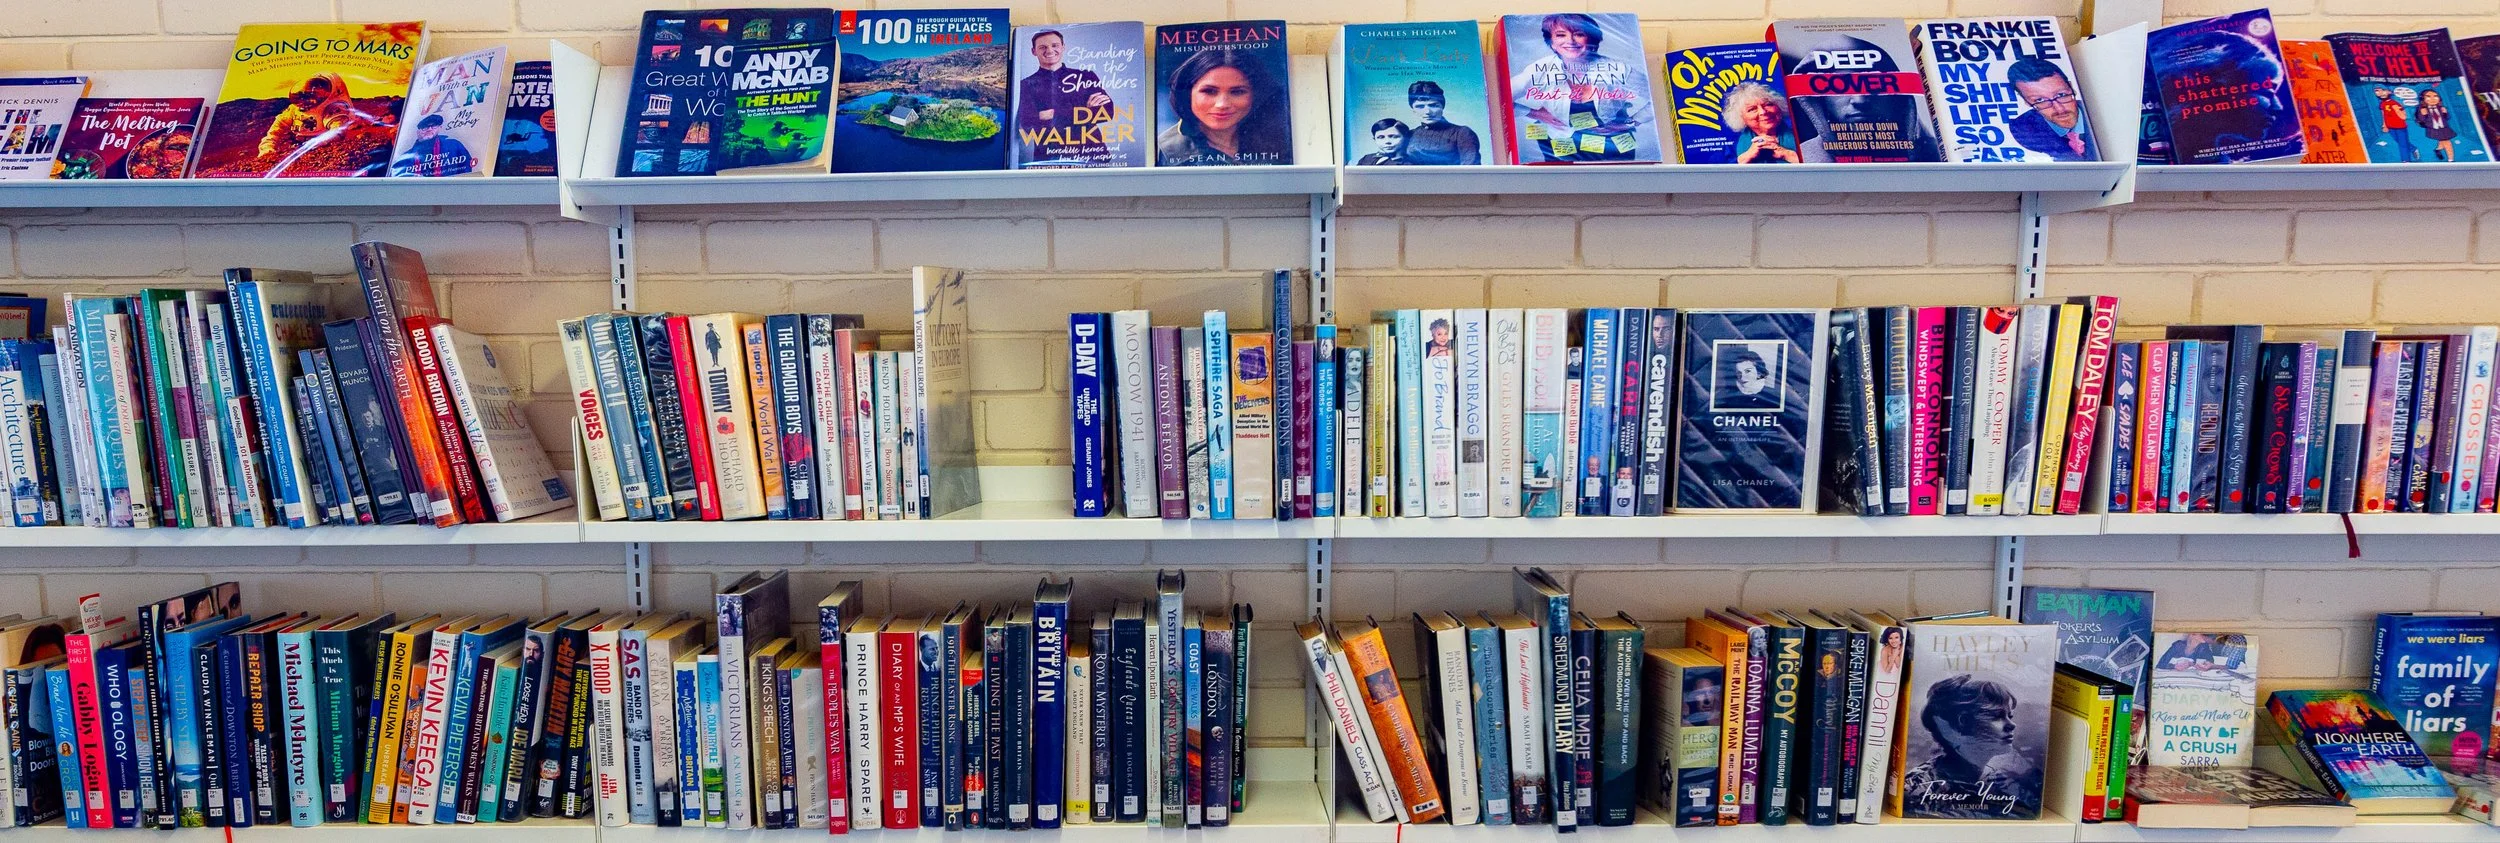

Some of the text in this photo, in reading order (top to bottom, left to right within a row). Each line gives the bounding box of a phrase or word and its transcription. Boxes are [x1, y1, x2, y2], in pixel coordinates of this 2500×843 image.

[859, 18, 911, 45] 100
[915, 34, 992, 44] IN IRELAND
[916, 23, 992, 33] BEST PLACES
[1161, 26, 1281, 46] MEGHAN
[1360, 30, 1407, 38] CHARLES
[1927, 21, 2054, 39] FRANKIE
[235, 38, 318, 62] GOING
[326, 40, 349, 51] TO
[354, 40, 413, 60] MARS
[1066, 42, 1138, 64] Standing
[1174, 42, 1269, 53] MISUNDERSTOOD
[1932, 38, 2061, 62] BOYLE
[2351, 42, 2429, 57] WELCOME TO
[266, 56, 294, 65] STORIES
[743, 49, 821, 72] ANDY
[1079, 60, 1127, 75] on the
[1535, 62, 1619, 74] MAUREEN
[1814, 50, 1881, 70] DEEP
[2357, 54, 2439, 76] ST. HELL
[732, 66, 829, 91] McNAB
[1061, 74, 1138, 94] Shoulders
[1531, 73, 1626, 87] LIPMAN
[1810, 73, 1899, 95] COVER
[1938, 63, 1990, 83] MY
[2174, 73, 2211, 90] this
[736, 95, 770, 108] THE
[772, 91, 821, 105] HUNT
[1526, 87, 1637, 101] Past-it Notes
[1944, 83, 2018, 104] SHIT
[2178, 76, 2273, 104] shattered
[455, 109, 474, 120] My
[1073, 104, 1134, 125] DAN
[1950, 104, 2018, 125] LIFE
[2181, 96, 2259, 119] promise
[81, 115, 181, 133] The Melting
[445, 118, 479, 132] Story
[1019, 124, 1136, 146] WALKER
[1830, 123, 1848, 131] HOW
[1854, 123, 1874, 131] TOOK
[1877, 123, 1898, 131] DOWN
[99, 132, 135, 150] Pot
[1823, 141, 1914, 151] DANGEROUS GANGSTERS
[1837, 132, 1895, 141] BRITAIN'S MOST
[1955, 126, 2005, 146] SO
[406, 156, 466, 174] PRITCHARD
[425, 152, 449, 161] Drew
[1189, 153, 1226, 162] SEAN
[1235, 152, 1279, 160] SMITH
[1075, 323, 1096, 377] D-DAY
[1592, 319, 1608, 369] MICHAEL
[2077, 304, 2116, 422] TOM DALEY
[2121, 352, 2133, 379] ACE
[2154, 347, 2162, 373] CLAP
[339, 368, 368, 379] EDVARD
[342, 376, 370, 387] MUNCH
[412, 328, 450, 417] BLOODY BRITAIN
[778, 326, 802, 434] THE GLAMOUR BOYS
[1209, 330, 1223, 420] SPITFIRE SAGA
[1465, 321, 1480, 435] MELVYN BRAGG
[708, 367, 733, 413] TOMMY
[1589, 371, 1606, 408] CAINE
[2151, 374, 2161, 405] WHEN
[1083, 388, 1091, 426] UNHEARD
[1645, 354, 1667, 463] cavendish
[1913, 329, 1929, 487] WINDSWEPT & INTERESTING
[1925, 324, 1944, 489] BILLY CONNOLLY
[1713, 416, 1781, 427] CHANEL
[2119, 403, 2130, 450] SPADES
[2149, 407, 2159, 433] YOU
[2146, 435, 2157, 460] LAND
[2037, 591, 2144, 620] BATMAN
[2064, 634, 2120, 644] ASYLUM
[2407, 633, 2485, 644] we were liars
[69, 656, 88, 664] HALF
[891, 643, 903, 681] DIARY
[1038, 616, 1055, 703] BRITAIN
[2397, 654, 2491, 684] family
[894, 693, 901, 703] AN
[2424, 684, 2455, 708] of
[200, 654, 215, 763] CLAUDIA WINKLEMAN
[284, 643, 307, 786] Michael McIntyre
[894, 706, 903, 732] MP'S
[1575, 655, 1590, 761] CELIA IMRIE
[1742, 660, 1763, 776] JOANNA LUMLEY
[857, 644, 871, 804] PRINCE HARRY SPARE
[2163, 724, 2212, 738] DIARY
[2405, 709, 2467, 733] liars
[75, 682, 102, 791] Gabby Logan
[2163, 740, 2237, 754] A CRUSH
[2315, 732, 2406, 746] NOWHERE
[894, 734, 904, 767] WIFE
[2180, 755, 2219, 766] SARRA
[2358, 743, 2417, 756] EARTH
[1920, 781, 2019, 815] Forever Young
